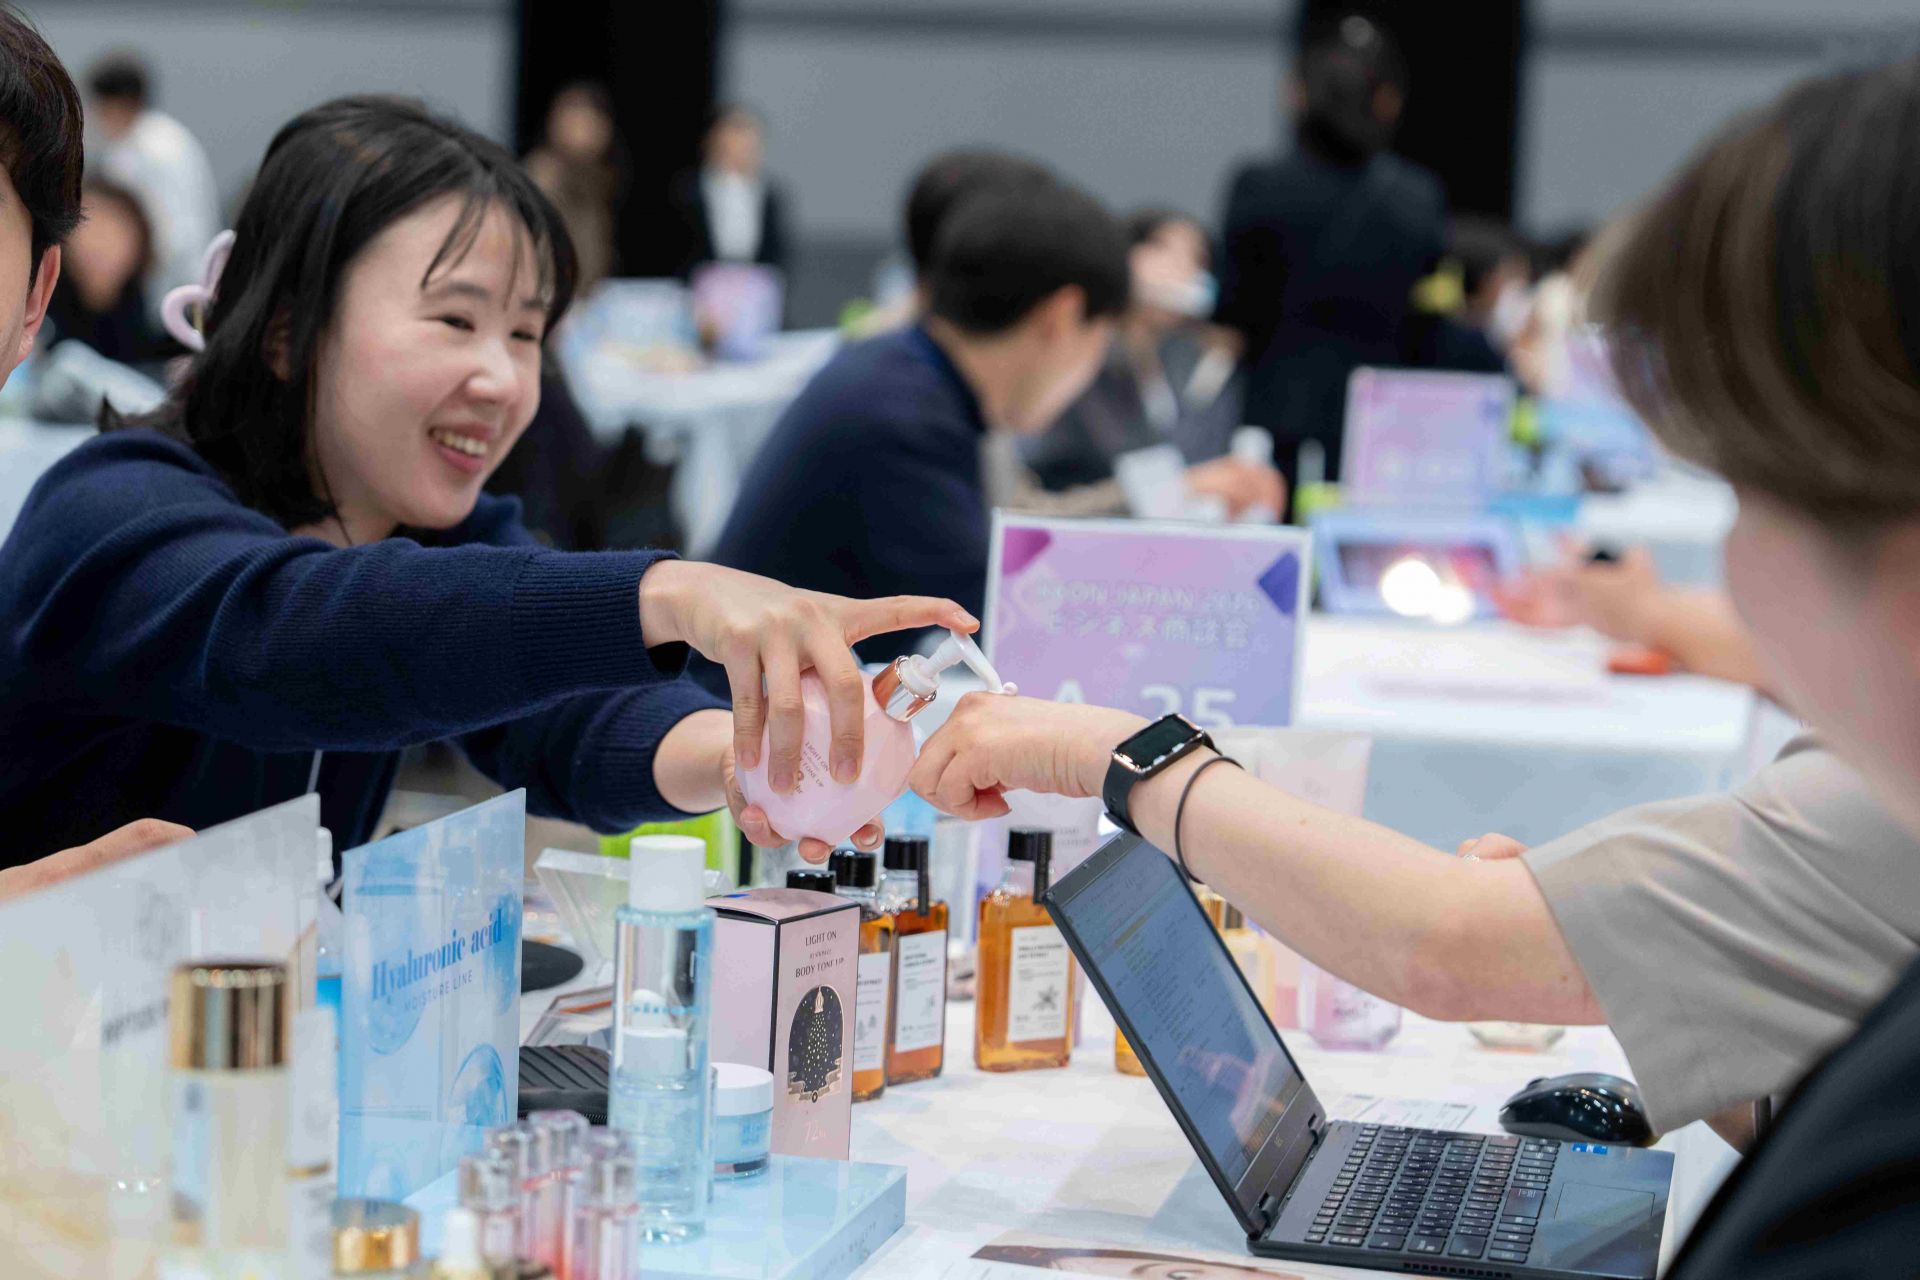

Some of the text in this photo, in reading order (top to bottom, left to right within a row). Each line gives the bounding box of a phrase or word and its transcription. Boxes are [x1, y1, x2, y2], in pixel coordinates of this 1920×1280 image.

[1140, 684, 1237, 730] 25
[372, 909, 502, 1005] Hyaluronic acid
[805, 930, 837, 947] LIGHT ON
[404, 970, 473, 1011] MOISTURE LINE
[795, 963, 815, 978] BODY
